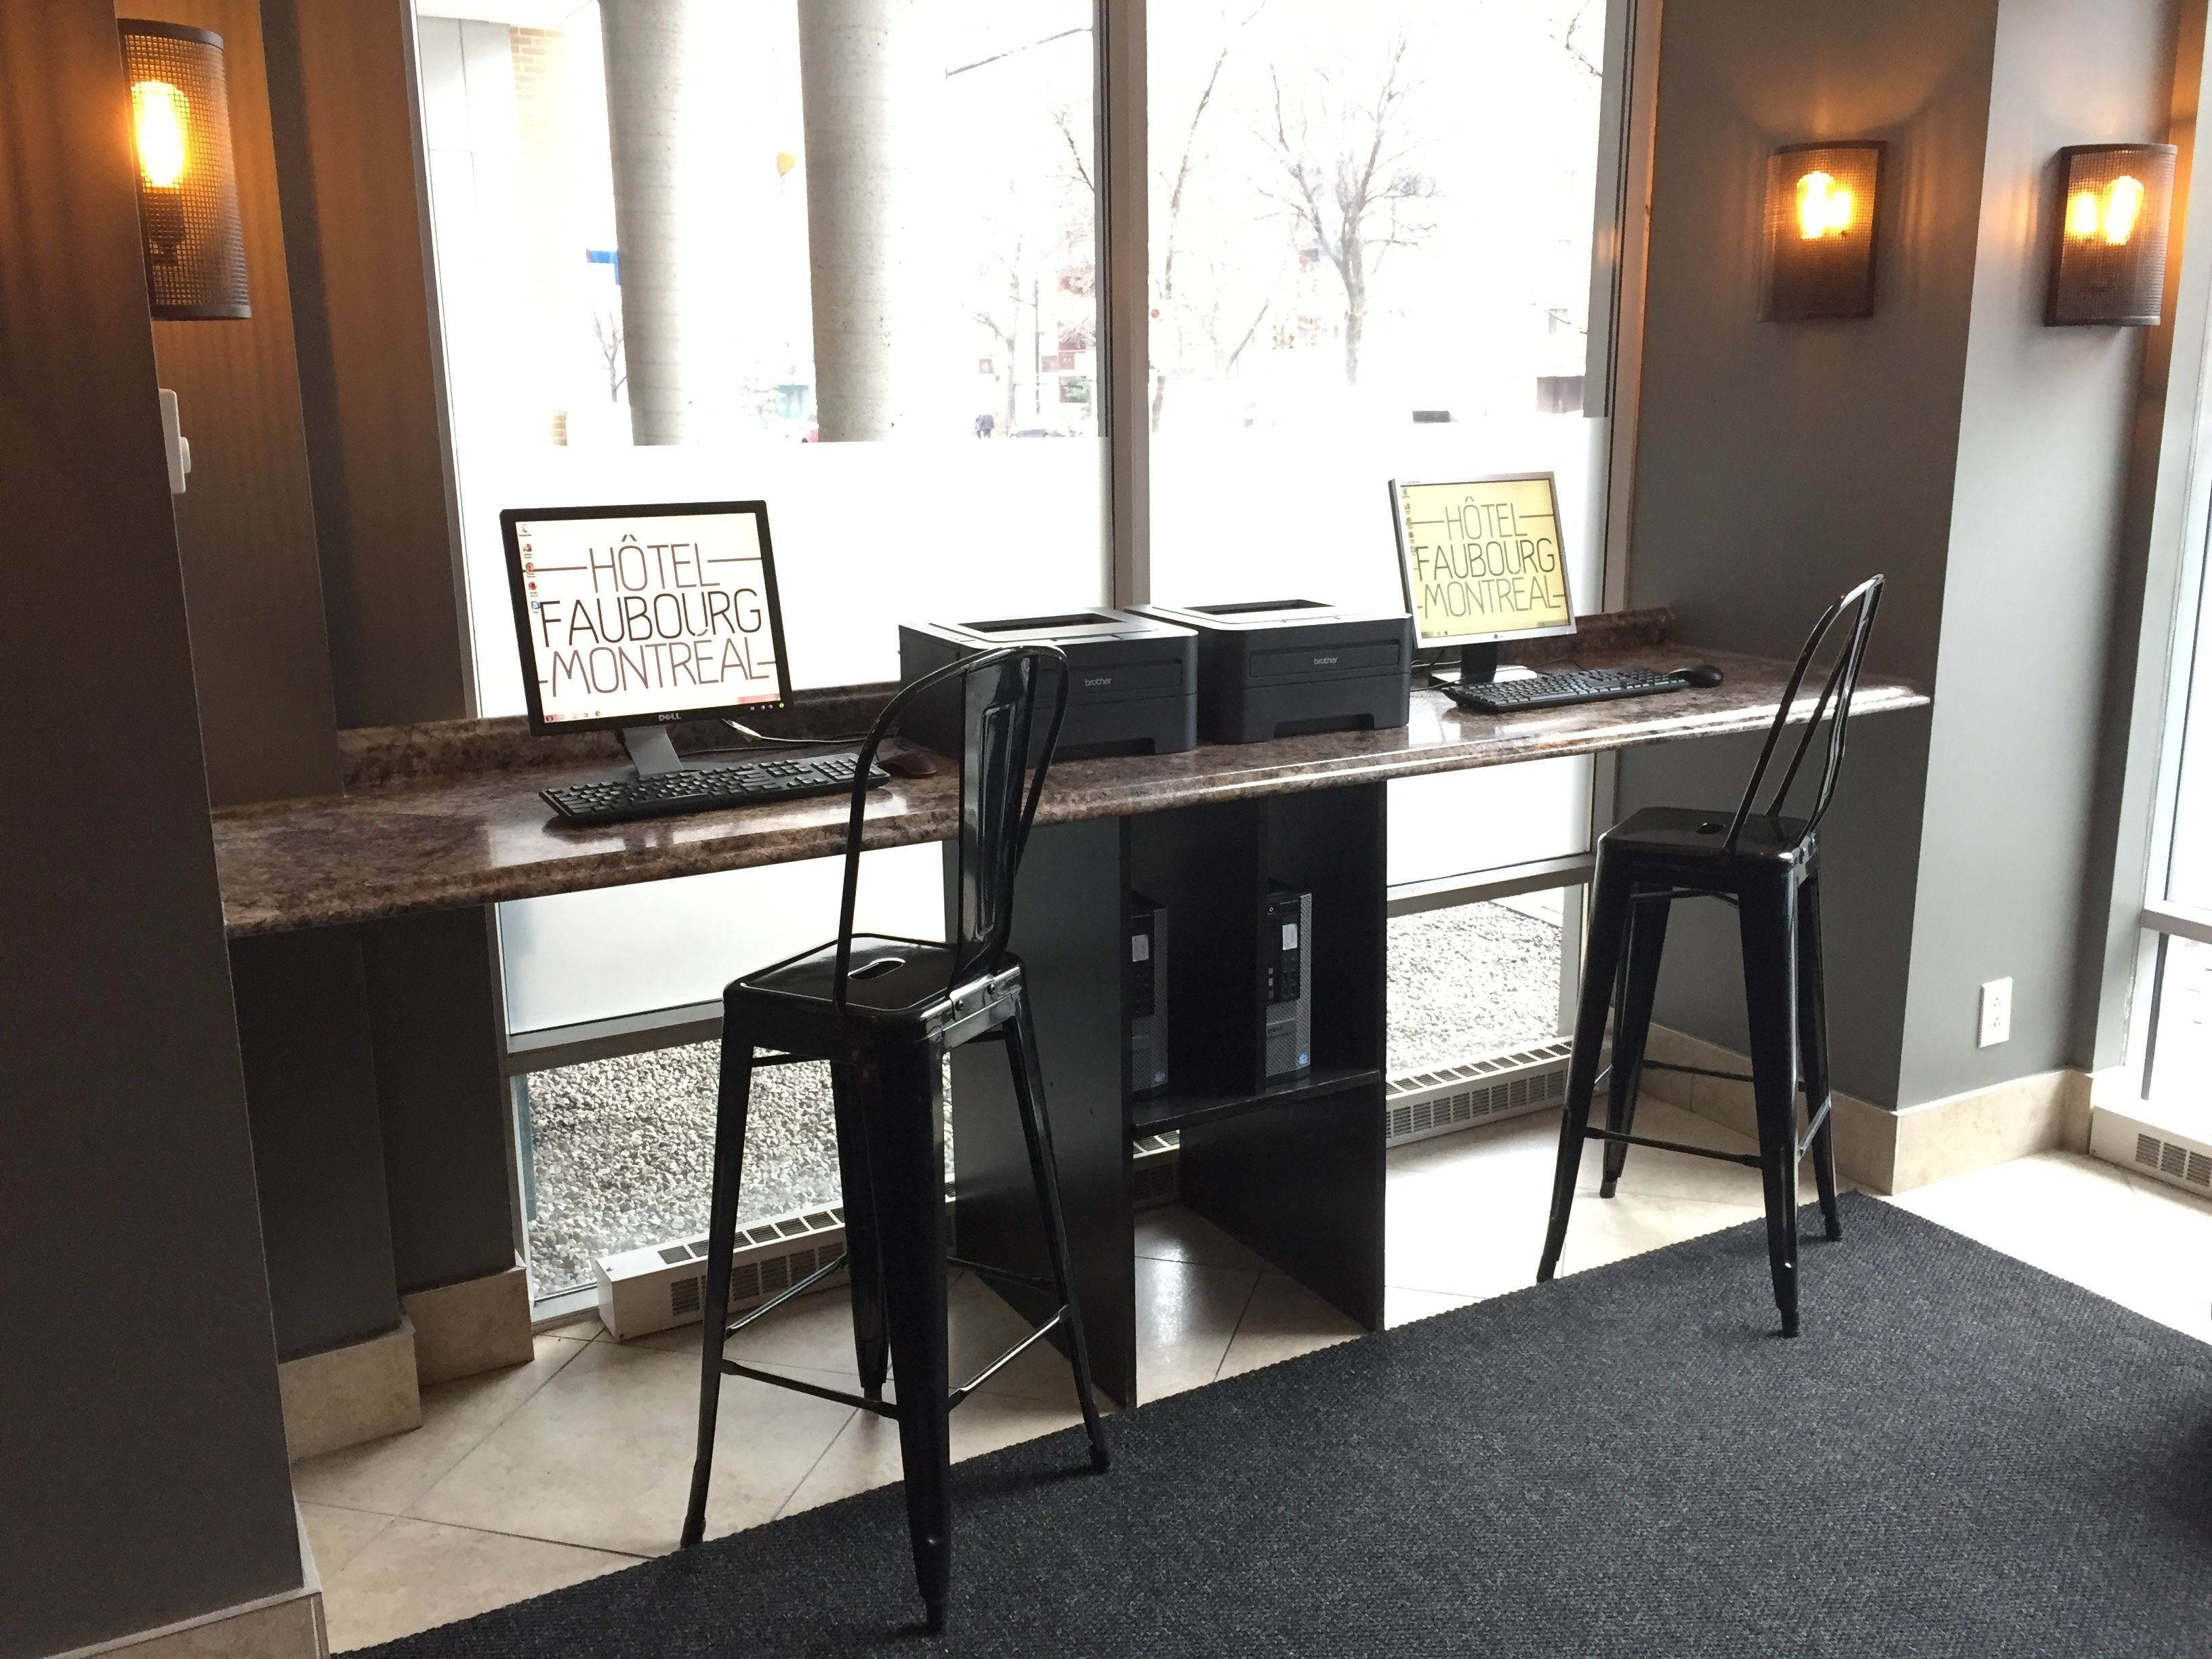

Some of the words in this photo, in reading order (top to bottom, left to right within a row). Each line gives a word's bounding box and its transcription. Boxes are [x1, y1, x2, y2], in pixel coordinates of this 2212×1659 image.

[1445, 496, 1528, 541] HÔTEL
[589, 534, 720, 593] HÔTEL
[1415, 537, 1555, 582] FAUBOURG
[540, 588, 762, 647] FAUBOURG
[1084, 678, 1112, 687] brother
[1313, 657, 1339, 665] brother
[657, 712, 682, 722] DELL
